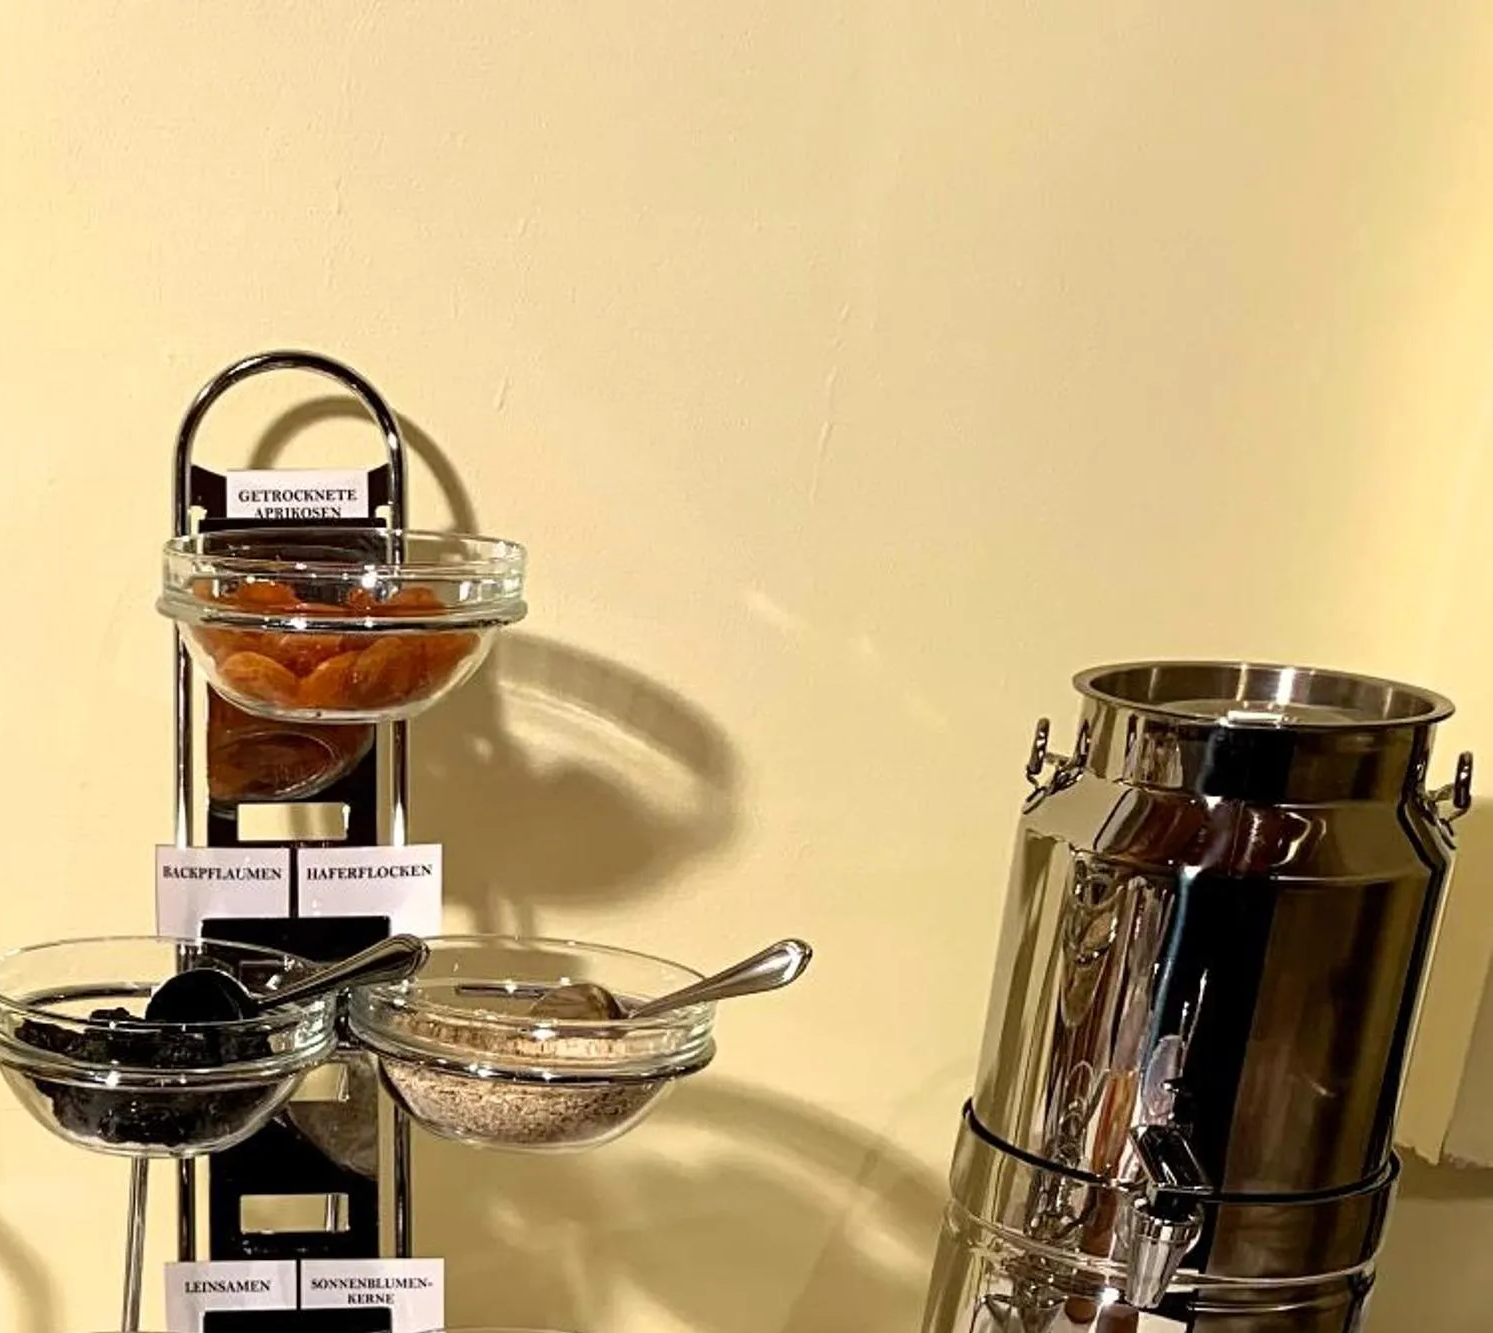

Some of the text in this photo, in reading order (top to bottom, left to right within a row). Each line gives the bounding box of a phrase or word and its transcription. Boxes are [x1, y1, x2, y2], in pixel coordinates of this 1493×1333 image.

[238, 488, 357, 502] GETROCKNETE
[254, 507, 342, 520] APRIKOSEN
[162, 864, 282, 880] BACKPFLAUMEN
[307, 864, 433, 880] HAFERFLOCKEN
[184, 1279, 271, 1293] LEINSAMEN
[310, 1277, 433, 1289] SONNENBLUMEN-
[347, 1293, 395, 1305] KERNE
